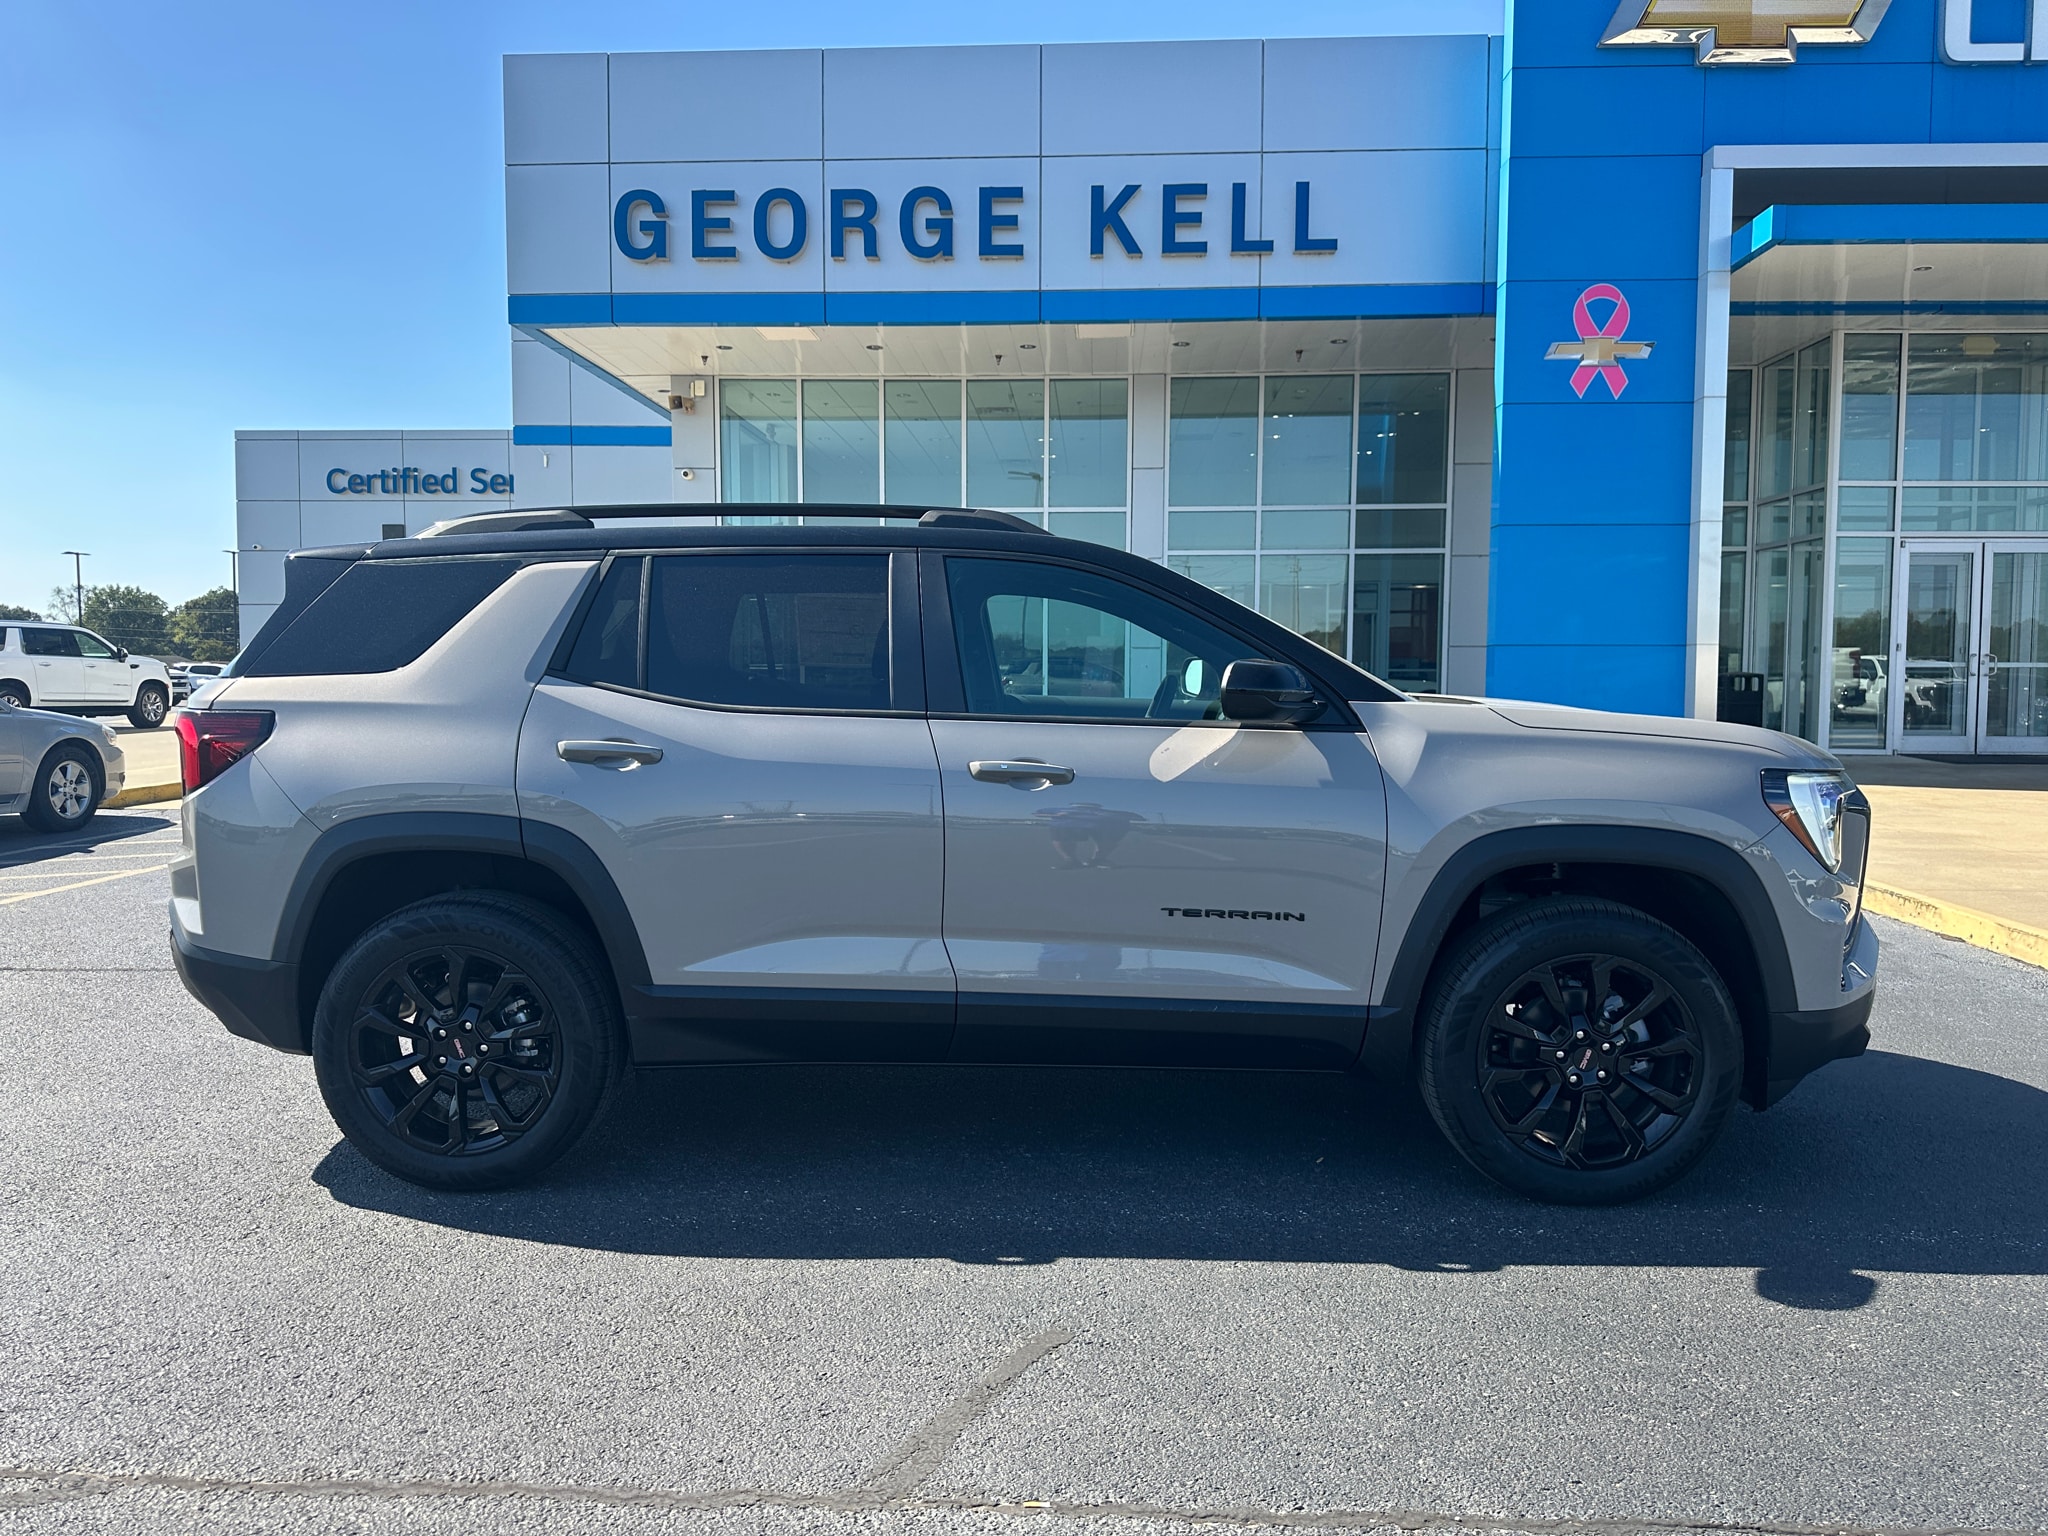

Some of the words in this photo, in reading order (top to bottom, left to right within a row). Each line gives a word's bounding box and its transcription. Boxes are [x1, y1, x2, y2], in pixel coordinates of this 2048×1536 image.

[614, 186, 1024, 261] GEORGE
[1090, 181, 1338, 257] KELL
[326, 467, 458, 494] Certified
[1160, 907, 1306, 922] TERRAIN
[453, 1038, 466, 1059] GMC
[1579, 1048, 1592, 1070] GMC
